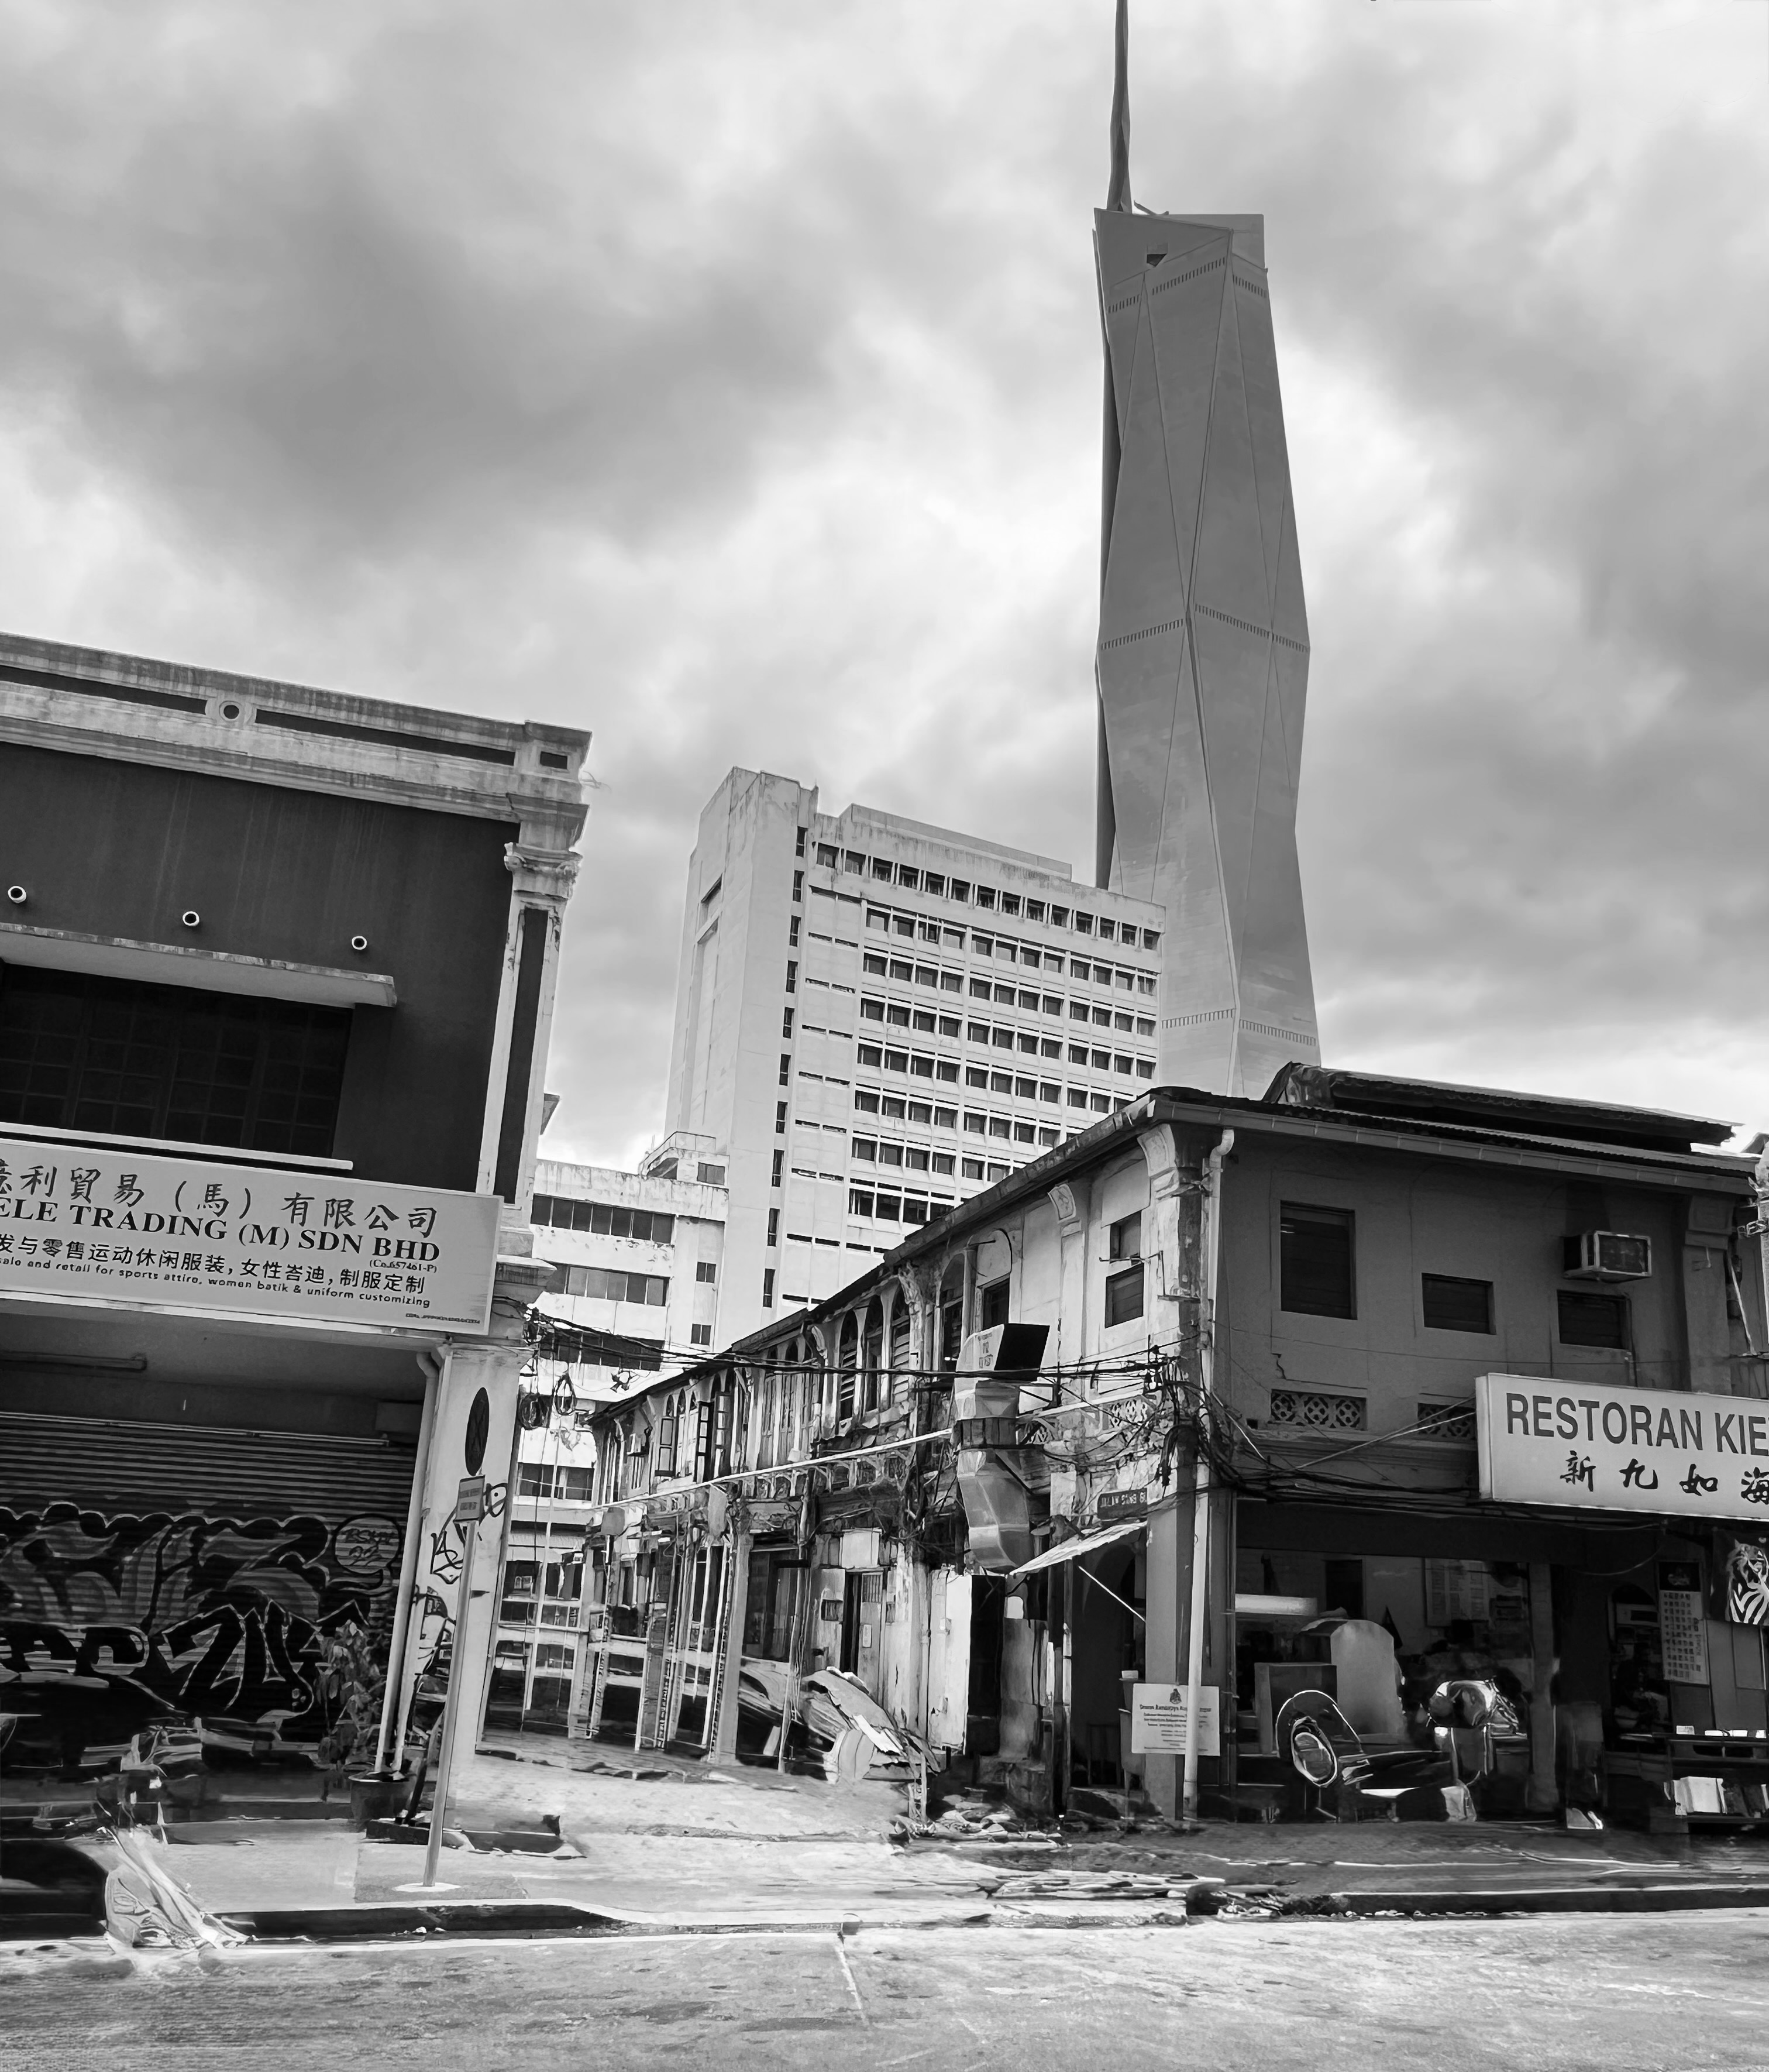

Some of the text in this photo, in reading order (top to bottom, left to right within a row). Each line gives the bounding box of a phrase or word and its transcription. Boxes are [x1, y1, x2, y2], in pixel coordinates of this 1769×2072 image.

[70, 1205, 227, 1239] TRADING
[239, 1224, 289, 1250] (M)
[298, 1230, 363, 1253] SDN
[372, 1238, 439, 1261] BHD
[27, 1260, 51, 1269] and
[56, 1264, 90, 1272] retail
[96, 1264, 113, 1274] for
[119, 1270, 158, 1279] sports
[257, 1281, 288, 1292] batik
[293, 1285, 301, 1293] &
[308, 1288, 353, 1298] uniform
[359, 1294, 430, 1308] customizing
[1506, 1393, 1769, 1456] RESTORAN KIE
